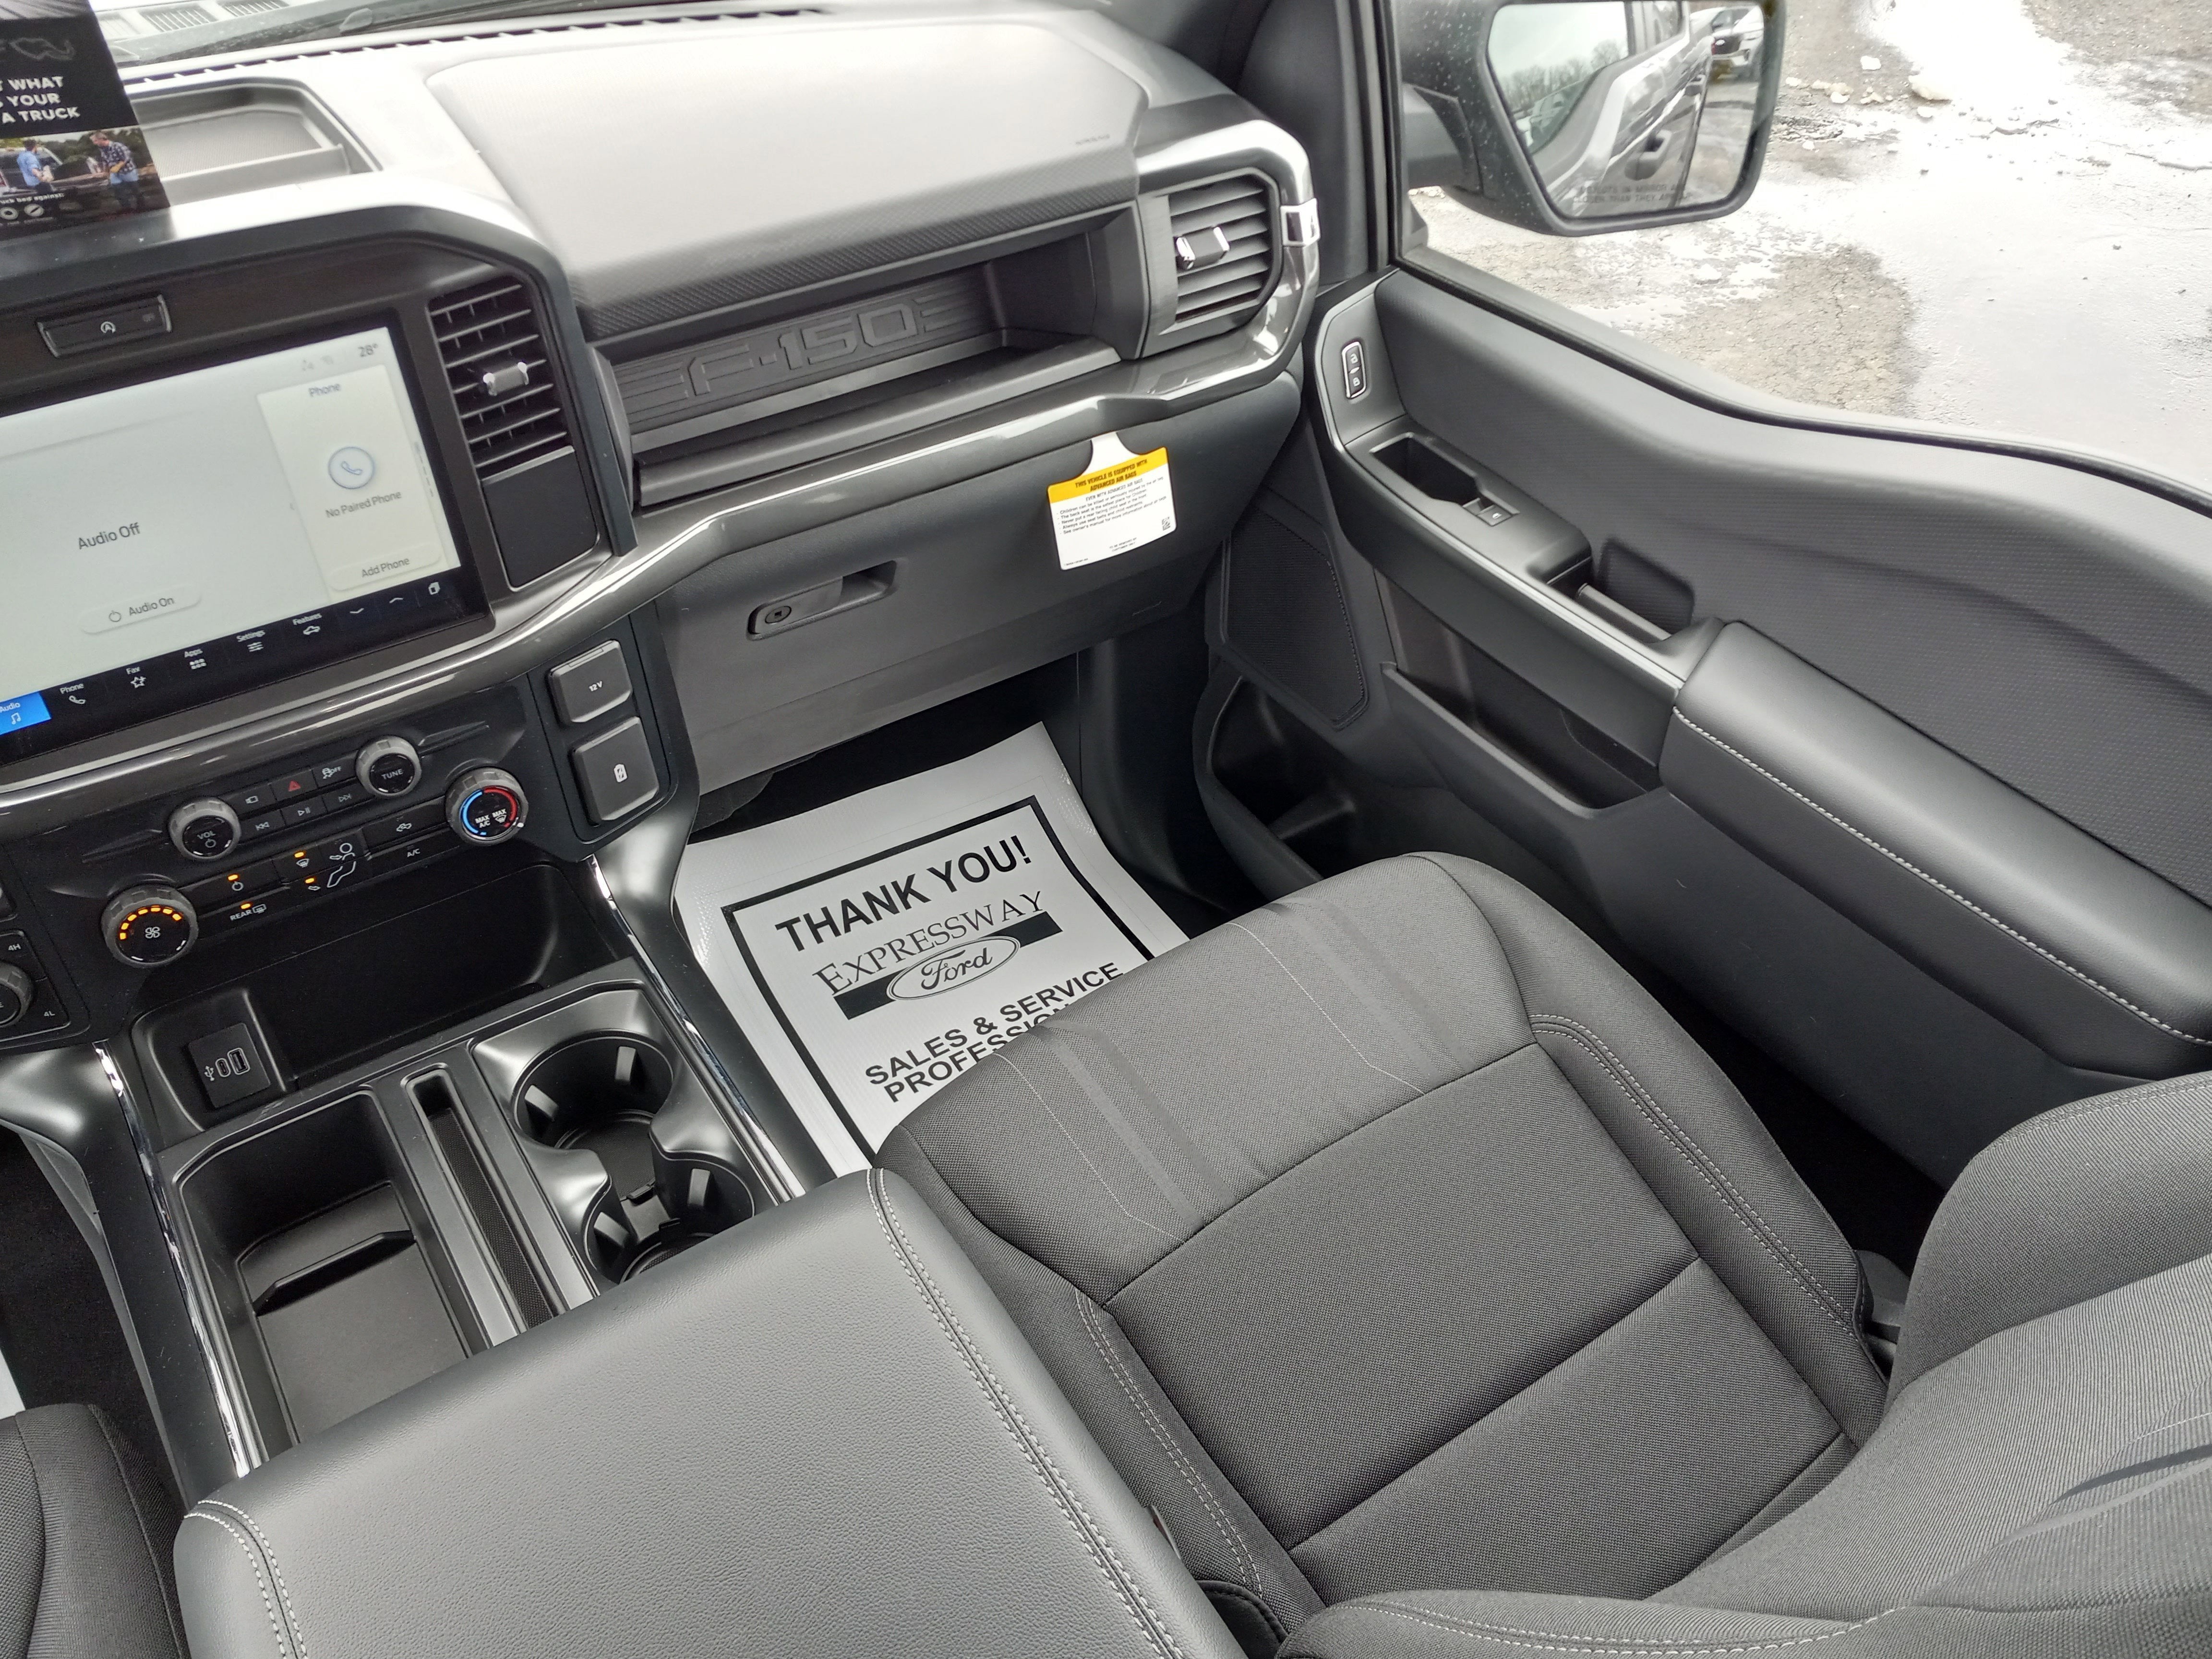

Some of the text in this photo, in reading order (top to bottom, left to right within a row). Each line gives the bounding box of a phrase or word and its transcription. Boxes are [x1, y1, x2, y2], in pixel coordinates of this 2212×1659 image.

[7, 76, 64, 90] WHAT
[6, 93, 61, 107] YOUR
[2, 107, 81, 123] A TRUCK
[308, 384, 341, 397] Phone
[1075, 480, 1086, 488] THIS
[1088, 473, 1106, 484] VEHICLE
[1114, 464, 1135, 476] EQUIPPED
[1137, 459, 1147, 467] WITH
[1090, 480, 1115, 491] ADVANCED
[1125, 471, 1137, 480] BAGS
[1107, 484, 1126, 494] ADVANCED
[325, 492, 402, 518] No Paired Phone
[78, 522, 140, 549] Audio Off
[361, 558, 410, 577] Add Phone
[129, 597, 175, 616] Audio On
[293, 613, 322, 625] Features
[236, 629, 266, 643] Settings
[184, 647, 203, 658] Apps
[126, 666, 141, 675] Fav
[60, 682, 84, 694] Phone
[0, 702, 21, 713] Audio
[381, 769, 404, 780] TUNE
[492, 808, 507, 817] MAX
[475, 815, 490, 824] MAX
[197, 830, 215, 840] VOL
[407, 849, 421, 858] A/C
[774, 835, 1032, 952] THANK YOU!
[229, 910, 252, 921] REAR
[8, 943, 21, 951] 4H
[812, 890, 1043, 996] EXPRESSWAY
[920, 947, 994, 990] Ford
[865, 962, 1124, 1085] SALES & SERVICE
